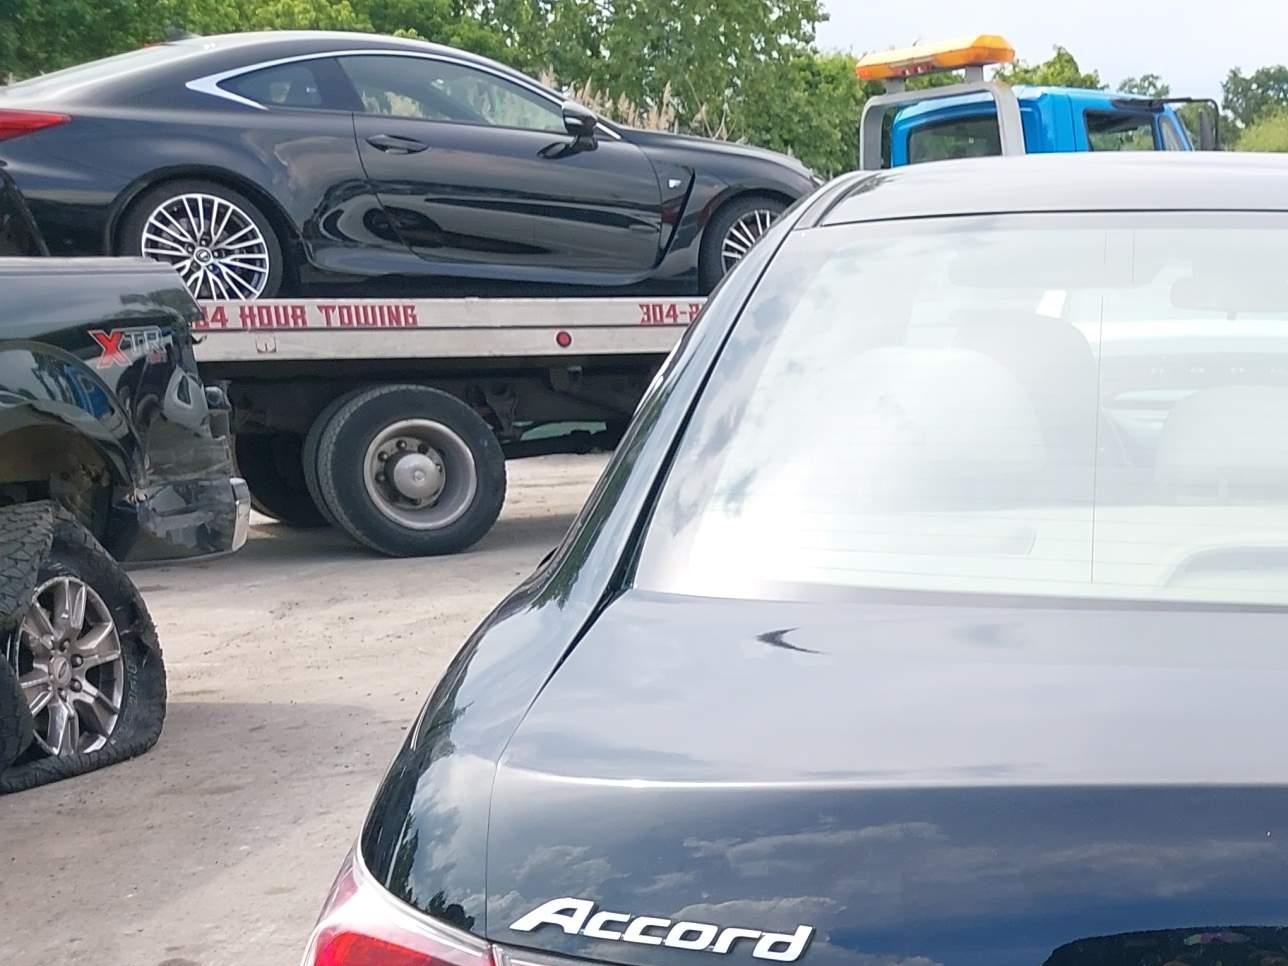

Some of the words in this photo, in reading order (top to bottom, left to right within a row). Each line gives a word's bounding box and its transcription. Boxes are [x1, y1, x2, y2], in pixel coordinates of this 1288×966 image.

[239, 305, 308, 327] HOUR
[317, 305, 418, 327] TOWING
[508, 897, 814, 962] Accord
